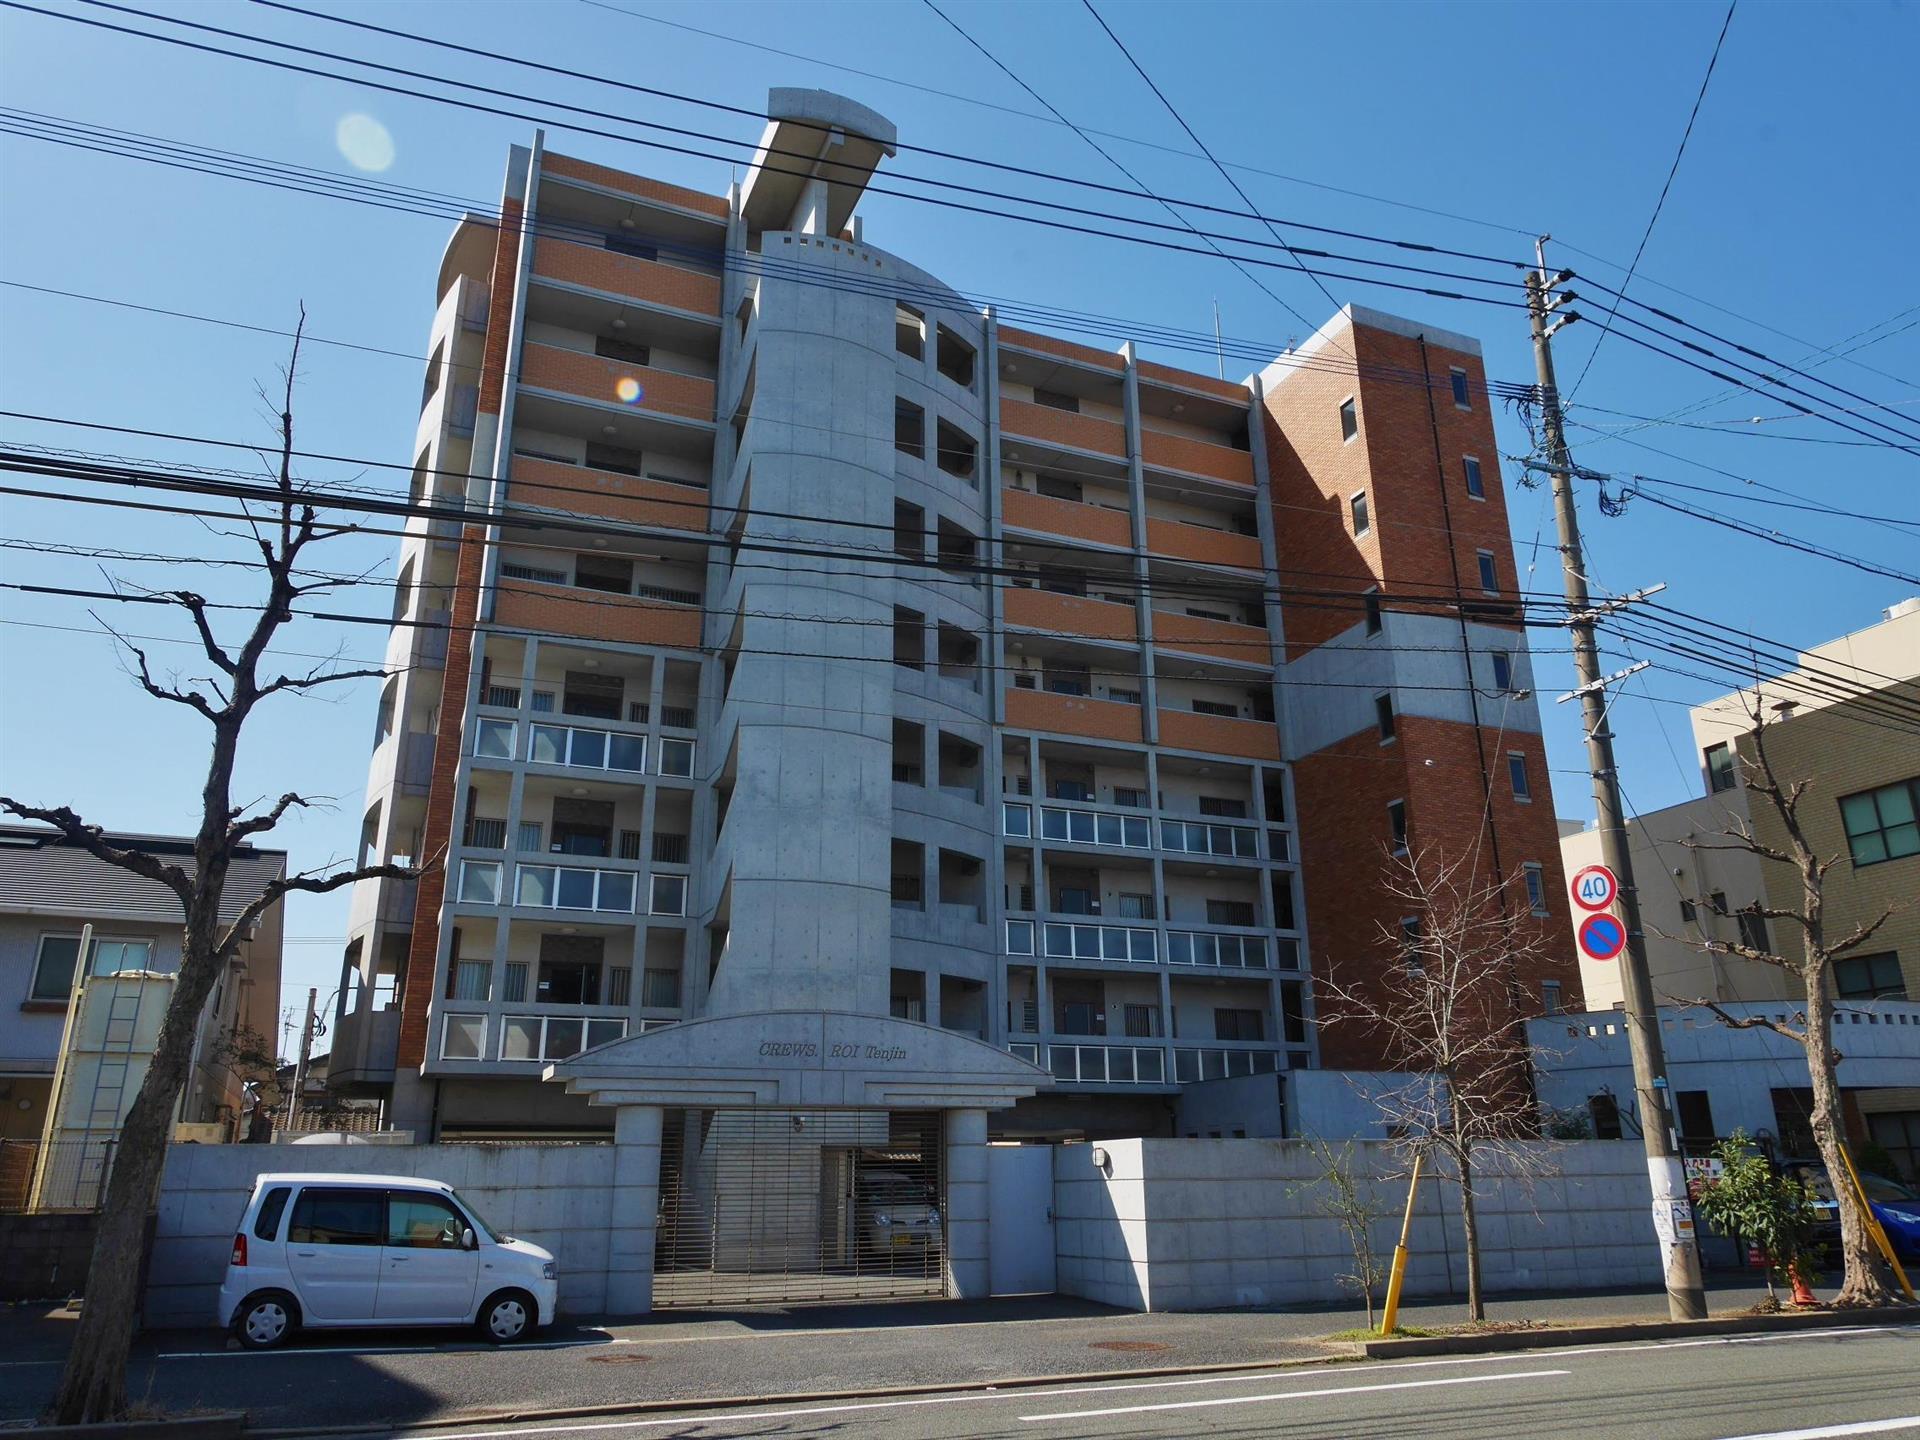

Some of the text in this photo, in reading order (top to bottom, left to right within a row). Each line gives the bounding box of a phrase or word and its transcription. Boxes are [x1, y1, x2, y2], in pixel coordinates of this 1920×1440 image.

[1582, 876, 1606, 898] 40
[830, 1044, 860, 1058] ROI
[865, 1045, 907, 1062] Tenjin
